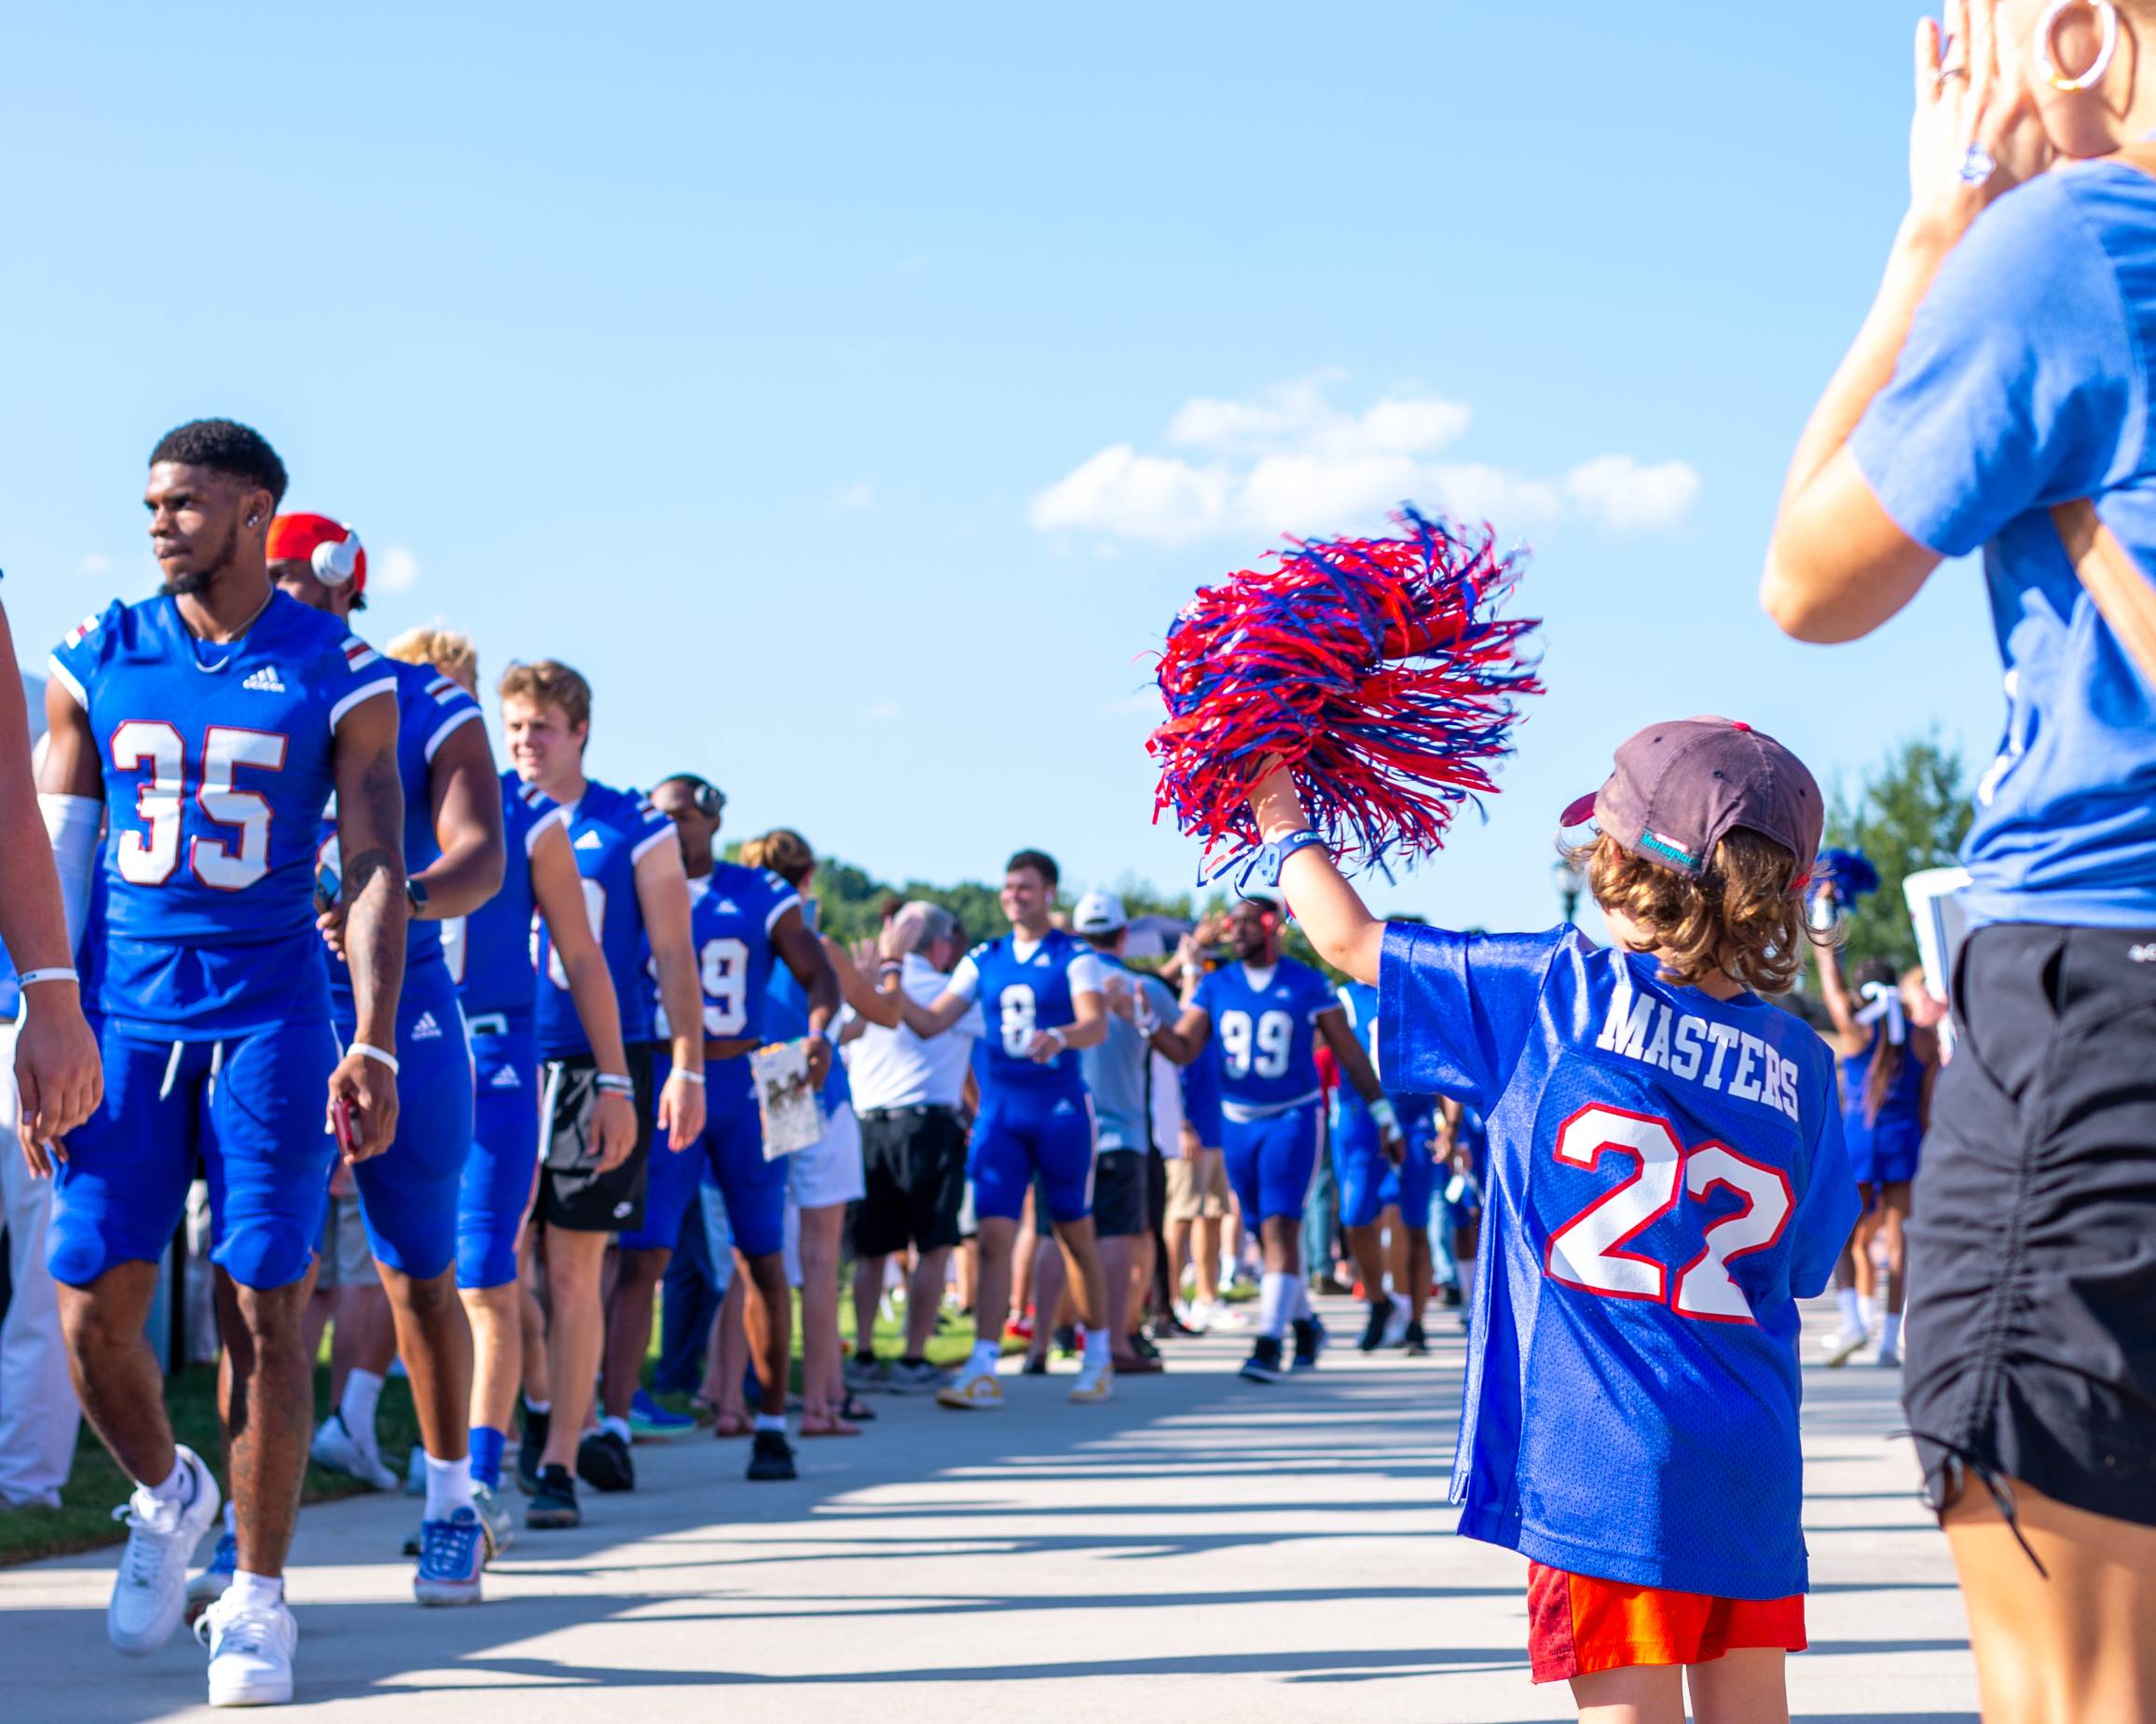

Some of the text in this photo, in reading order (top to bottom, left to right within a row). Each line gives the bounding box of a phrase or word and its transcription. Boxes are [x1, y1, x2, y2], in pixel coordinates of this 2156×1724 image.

[110, 718, 289, 892] 35
[646, 937, 748, 1037] 9
[999, 983, 1037, 1058] 8
[1219, 1008, 1294, 1080] 99
[1596, 984, 1799, 1123] MASTERS
[1544, 1101, 1797, 1331] 22
